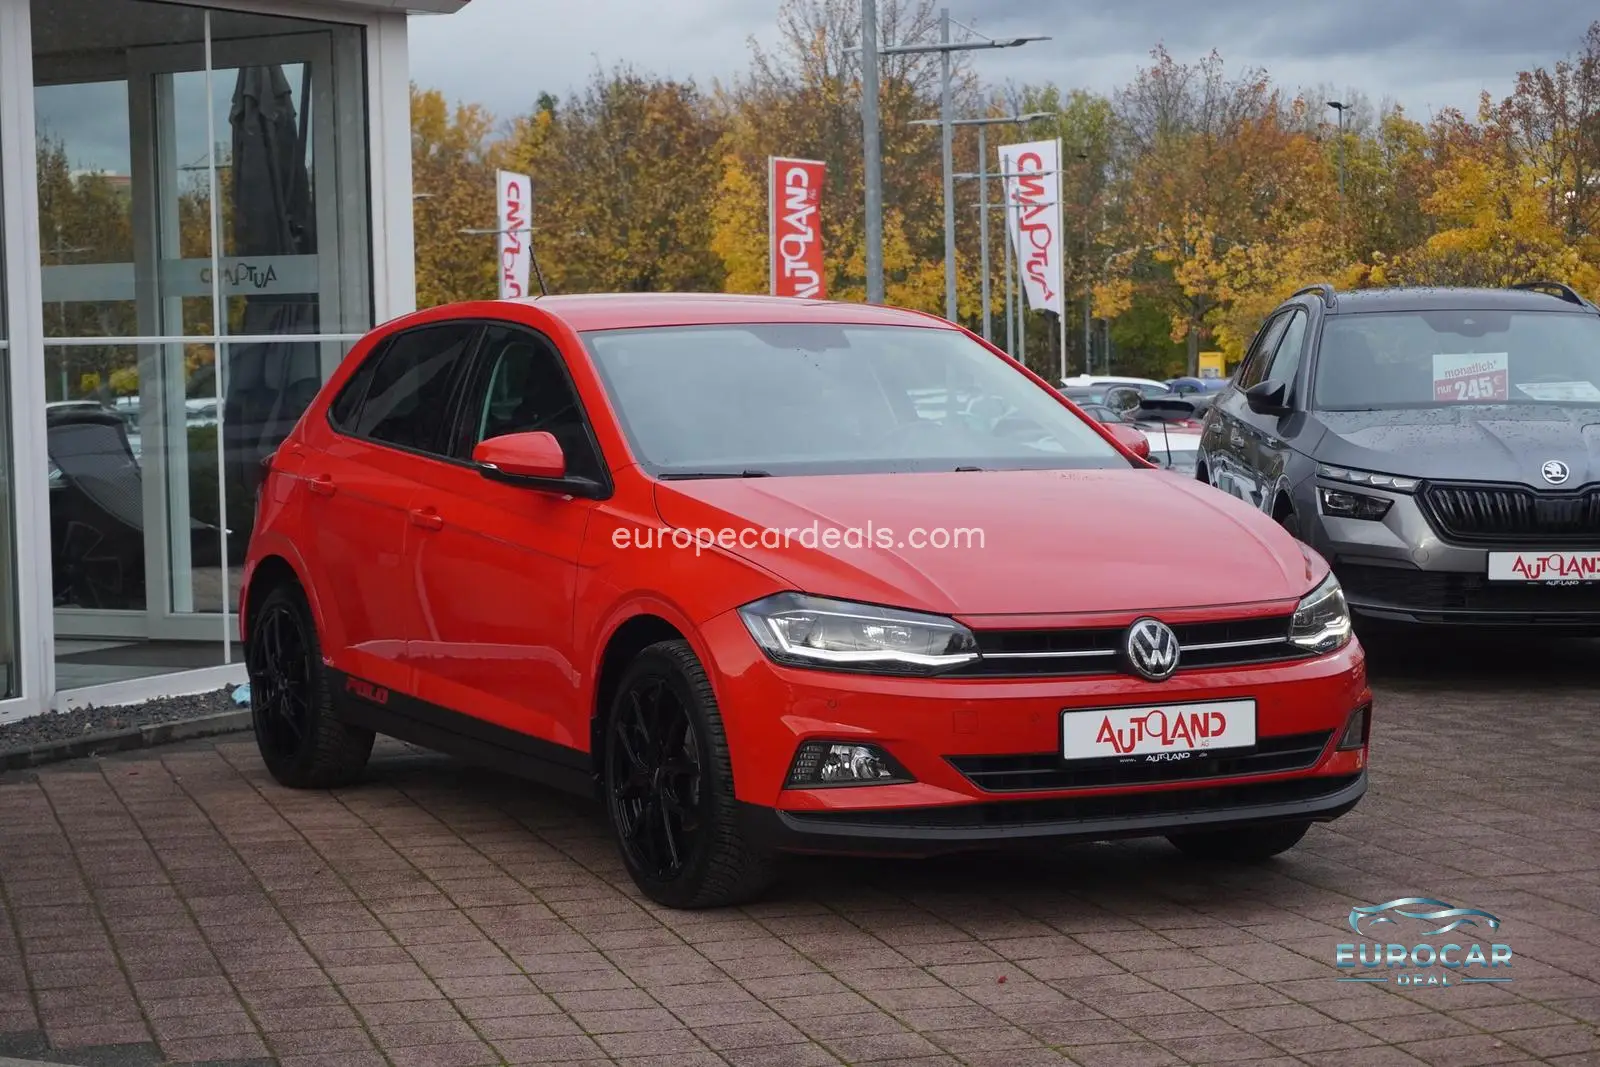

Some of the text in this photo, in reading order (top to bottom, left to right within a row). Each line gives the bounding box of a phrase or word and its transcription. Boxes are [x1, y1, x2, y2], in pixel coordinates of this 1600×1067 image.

[502, 181, 524, 298] UTOLAND
[1437, 384, 1452, 395] nur
[1511, 554, 1600, 579] AUTOLAN
[1096, 710, 1227, 753] AUTOLAND
